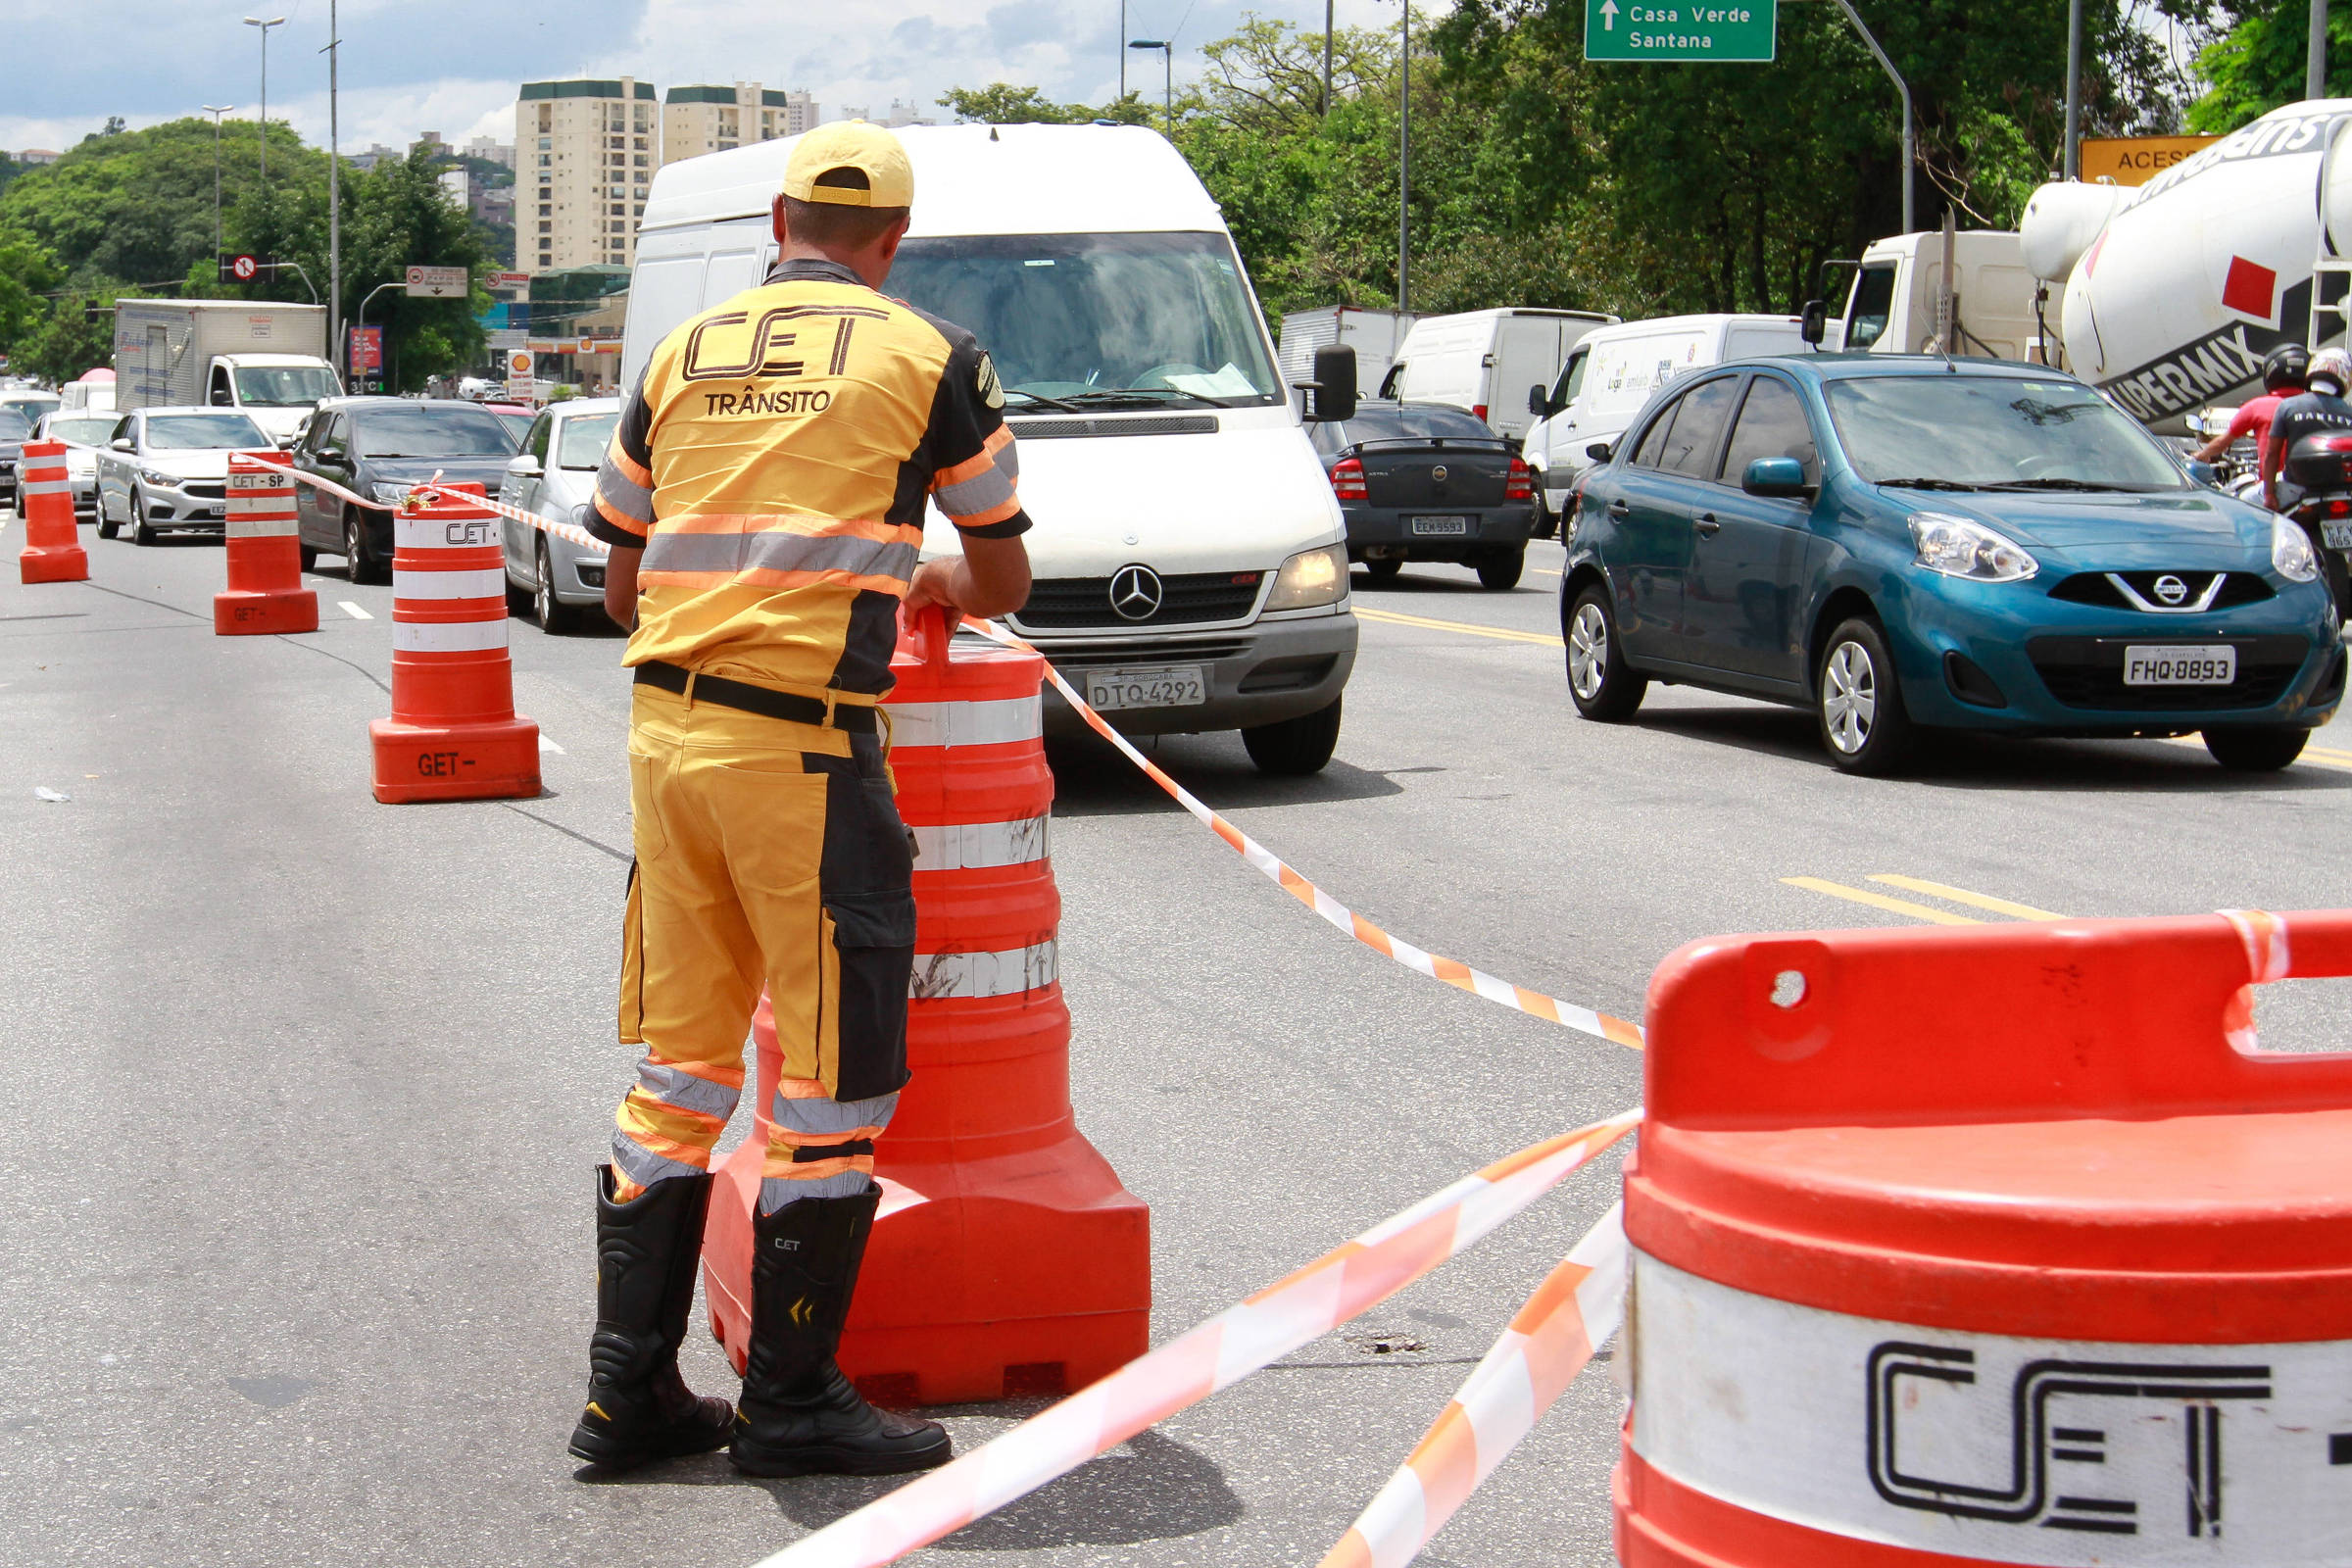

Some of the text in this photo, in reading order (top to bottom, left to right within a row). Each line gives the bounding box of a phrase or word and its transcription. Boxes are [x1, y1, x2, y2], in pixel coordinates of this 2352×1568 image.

[1630, 6, 1750, 23] Casa Verde
[1629, 32, 1712, 48] Santana
[682, 304, 891, 382] CET
[704, 385, 831, 416] TRÂNSITO
[232, 475, 258, 488] CET
[269, 474, 284, 488] SP
[446, 522, 490, 545] CET
[774, 1237, 801, 1251] CET
[1867, 1340, 2272, 1539] CET
